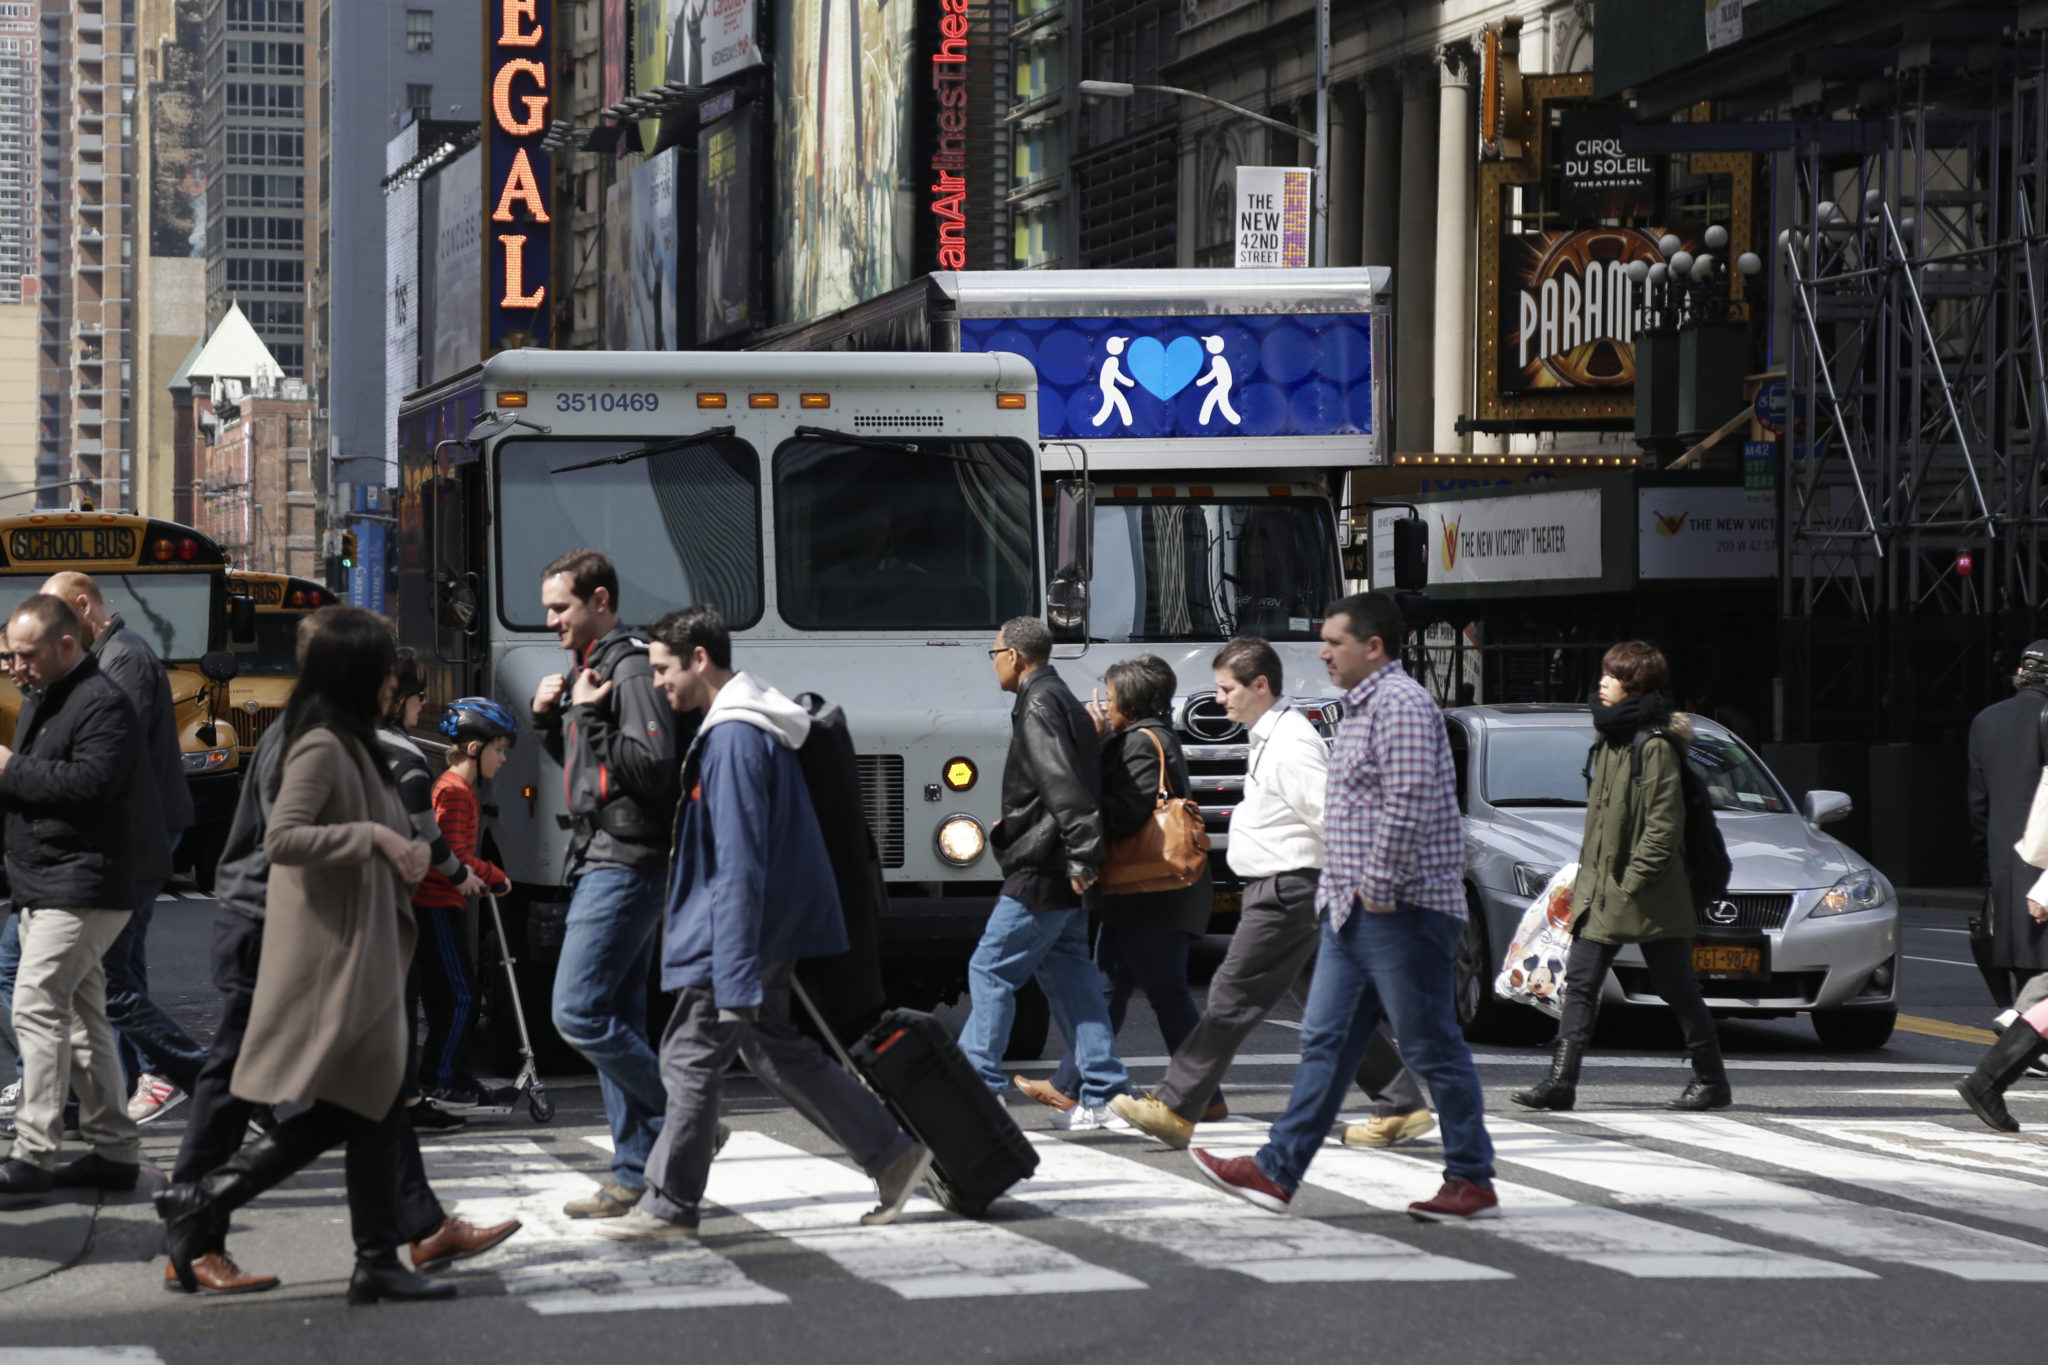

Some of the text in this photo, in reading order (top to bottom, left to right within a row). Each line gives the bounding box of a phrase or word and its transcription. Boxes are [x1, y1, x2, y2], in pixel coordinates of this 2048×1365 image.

[1565, 158, 1651, 176] DU SOLEIL
[1573, 179, 1643, 188] THEATRICAL
[1247, 193, 1274, 210] THE
[1241, 211, 1280, 231] NEW
[1240, 232, 1279, 249] 42ND
[1240, 250, 1280, 263] STREET
[556, 392, 659, 413] 3510469
[1745, 444, 1770, 456] M42
[1689, 518, 1713, 531] THE
[1716, 518, 1744, 531] NEW
[1748, 518, 1776, 531] VICT
[14, 530, 130, 559] SCHOOL BUS
[1460, 531, 1475, 558] THE
[1477, 530, 1493, 557] NEW
[1531, 525, 1566, 554] THEATER
